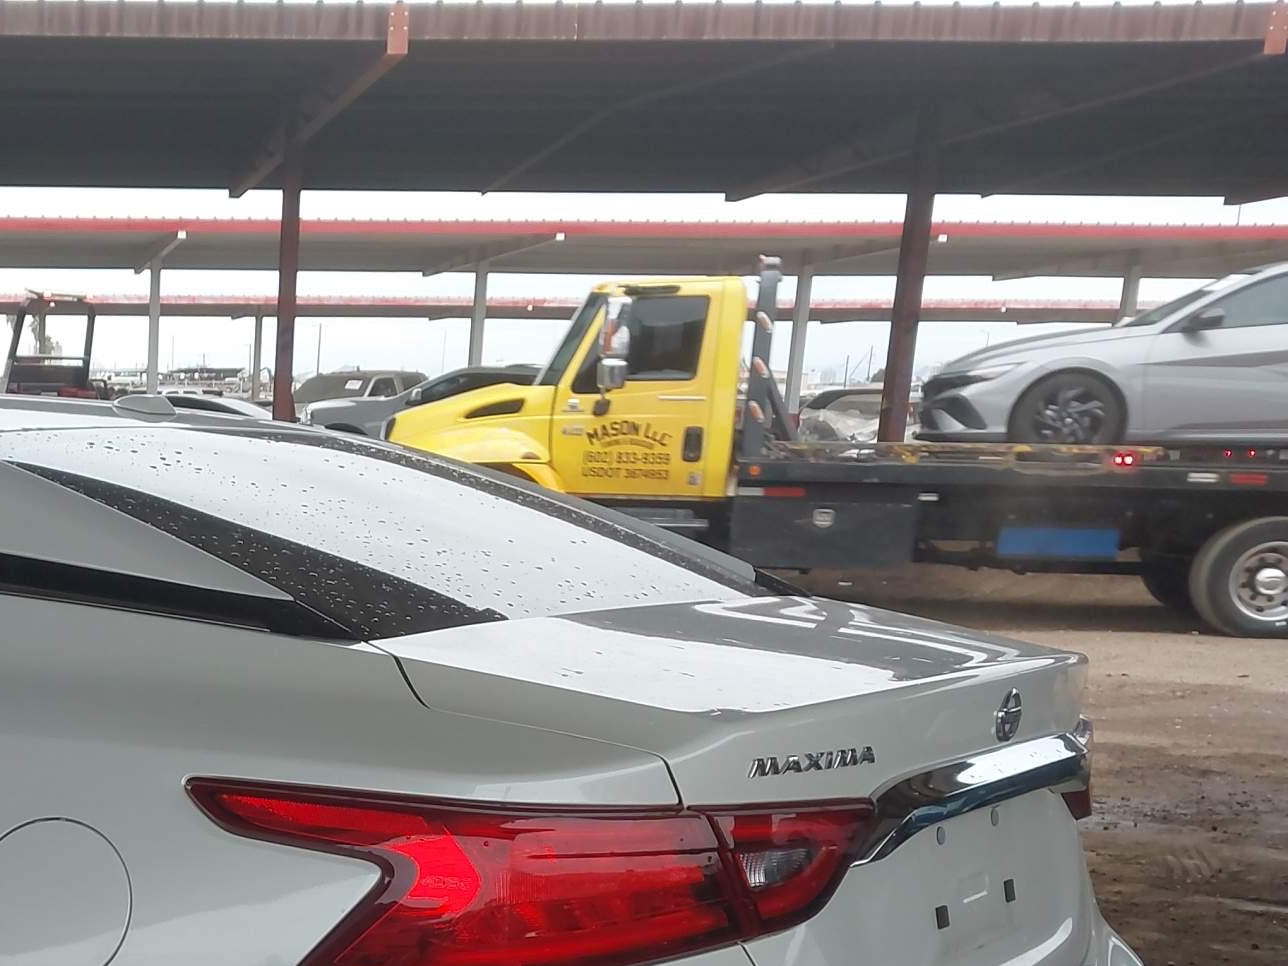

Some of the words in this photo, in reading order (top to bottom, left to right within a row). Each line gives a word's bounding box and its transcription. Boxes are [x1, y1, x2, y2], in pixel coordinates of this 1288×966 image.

[586, 419, 640, 446] MASON
[644, 422, 672, 447] LLC
[581, 466, 622, 479] USDOT
[748, 746, 876, 779] MAXIMA
